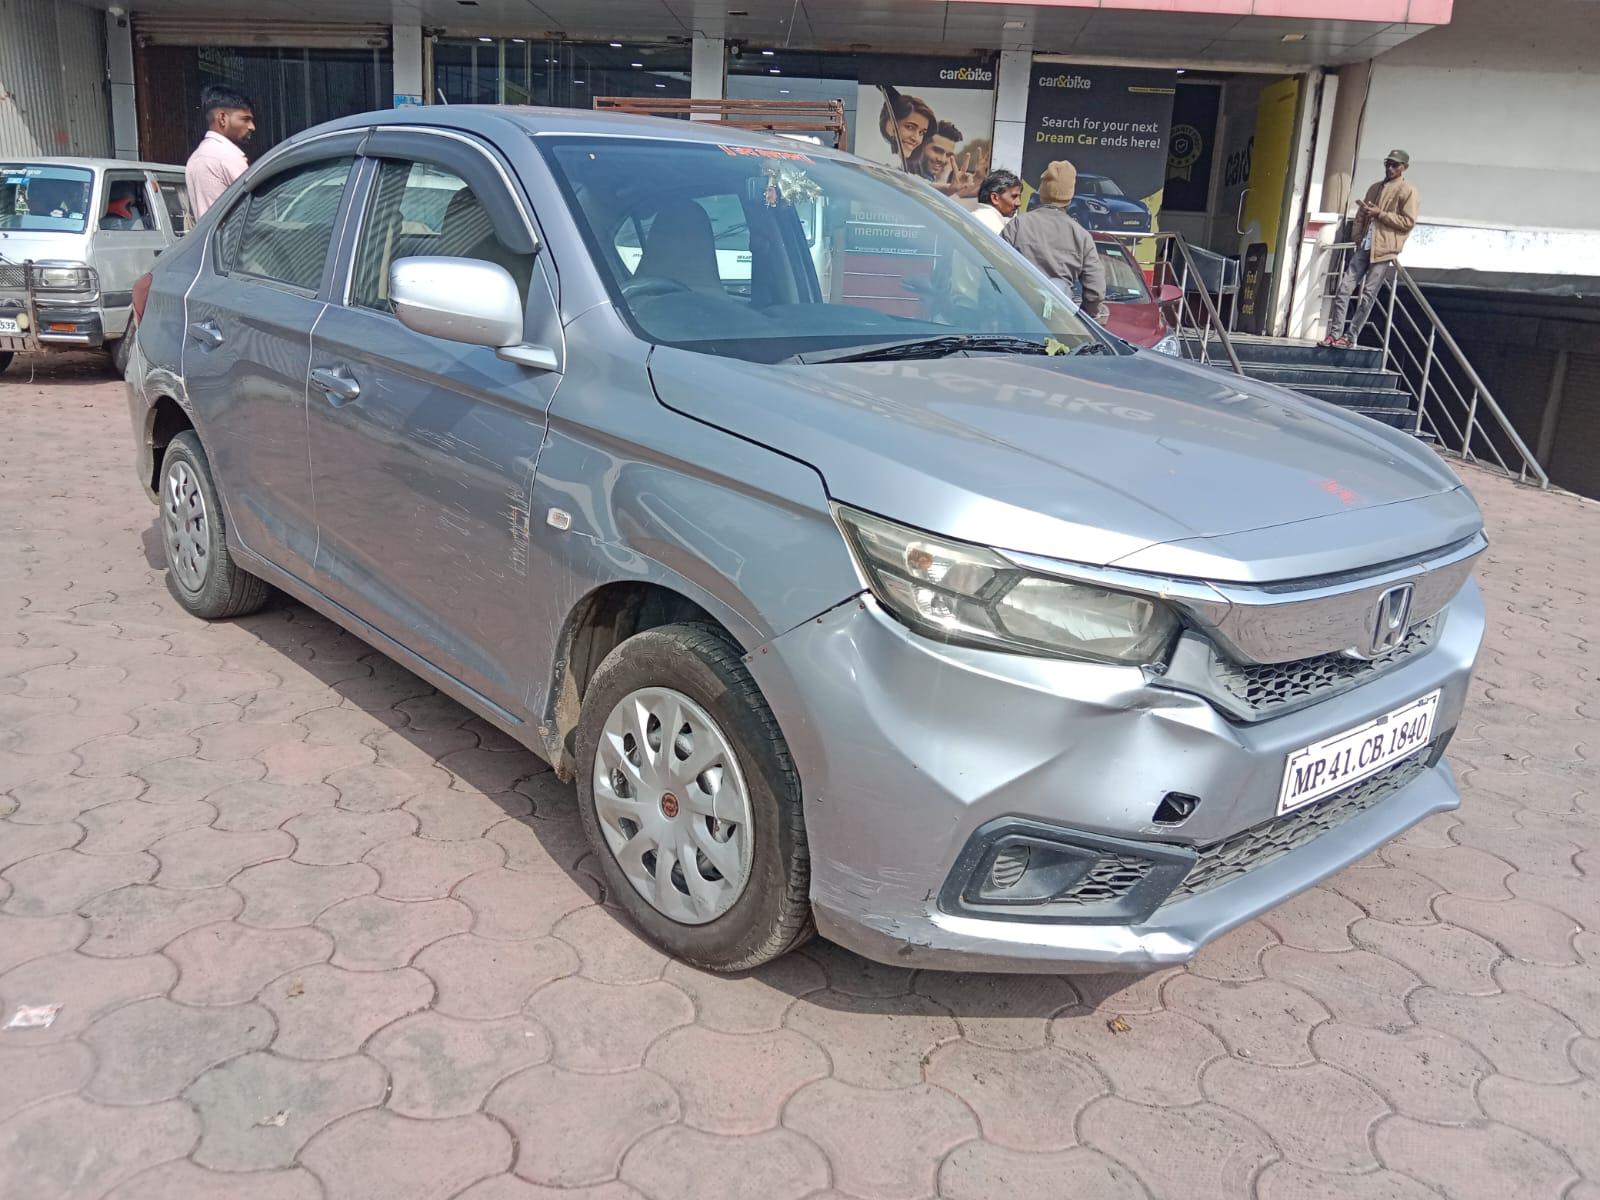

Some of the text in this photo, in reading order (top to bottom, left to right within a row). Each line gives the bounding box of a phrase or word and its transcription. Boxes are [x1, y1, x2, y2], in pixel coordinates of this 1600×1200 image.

[939, 67, 992, 81] car&bike
[1038, 75, 1091, 89] car&bike
[1042, 116, 1159, 133] Search for your next
[1035, 131, 1160, 149] Dream Car ends here!
